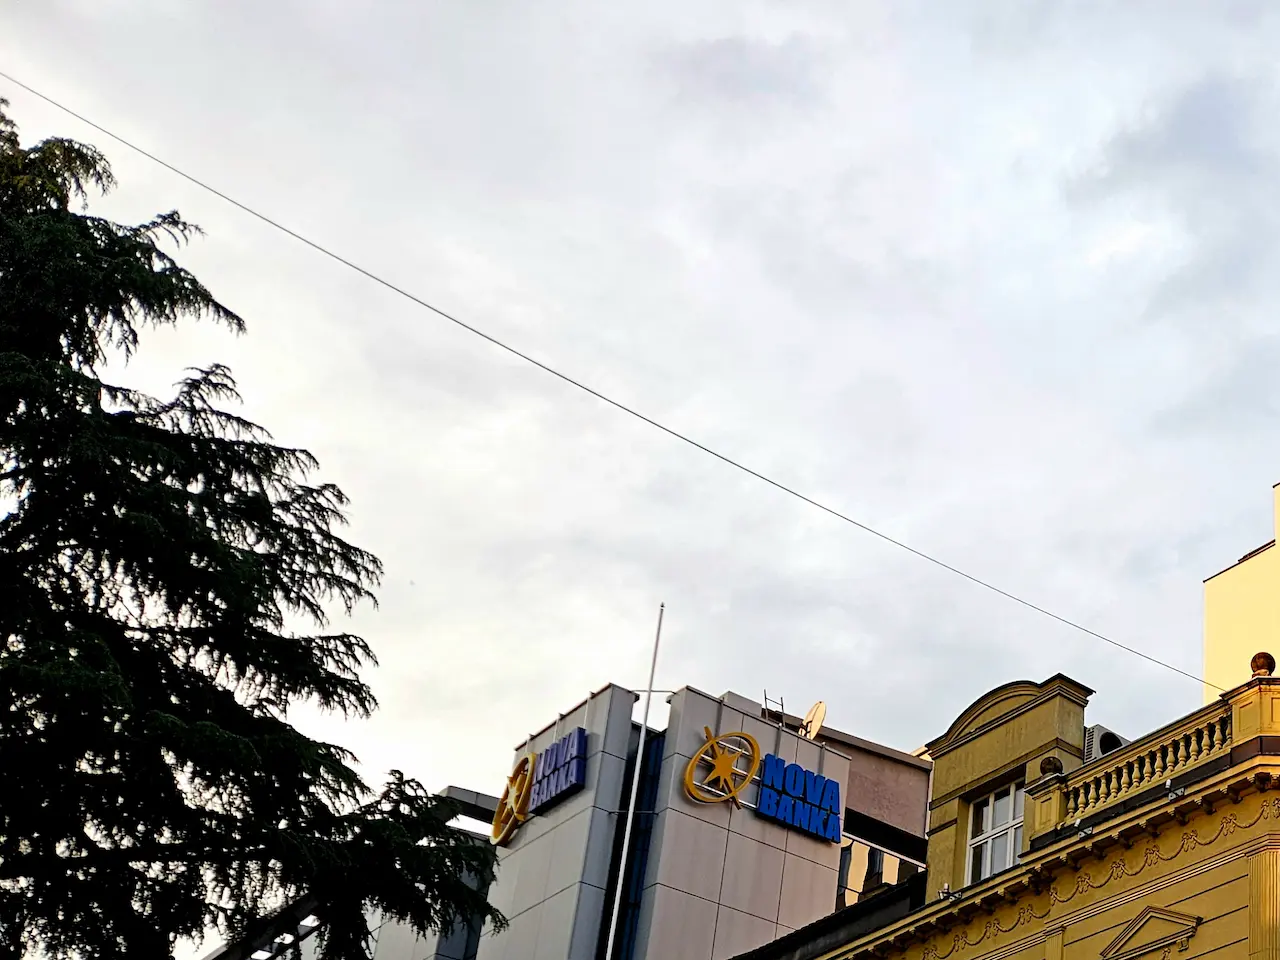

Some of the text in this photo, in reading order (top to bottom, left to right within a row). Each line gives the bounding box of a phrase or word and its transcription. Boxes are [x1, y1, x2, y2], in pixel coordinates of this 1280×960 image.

[533, 727, 579, 783] NOVA
[529, 757, 578, 812] BANKA
[763, 753, 840, 814] NOVA
[757, 789, 841, 843] BANKA
